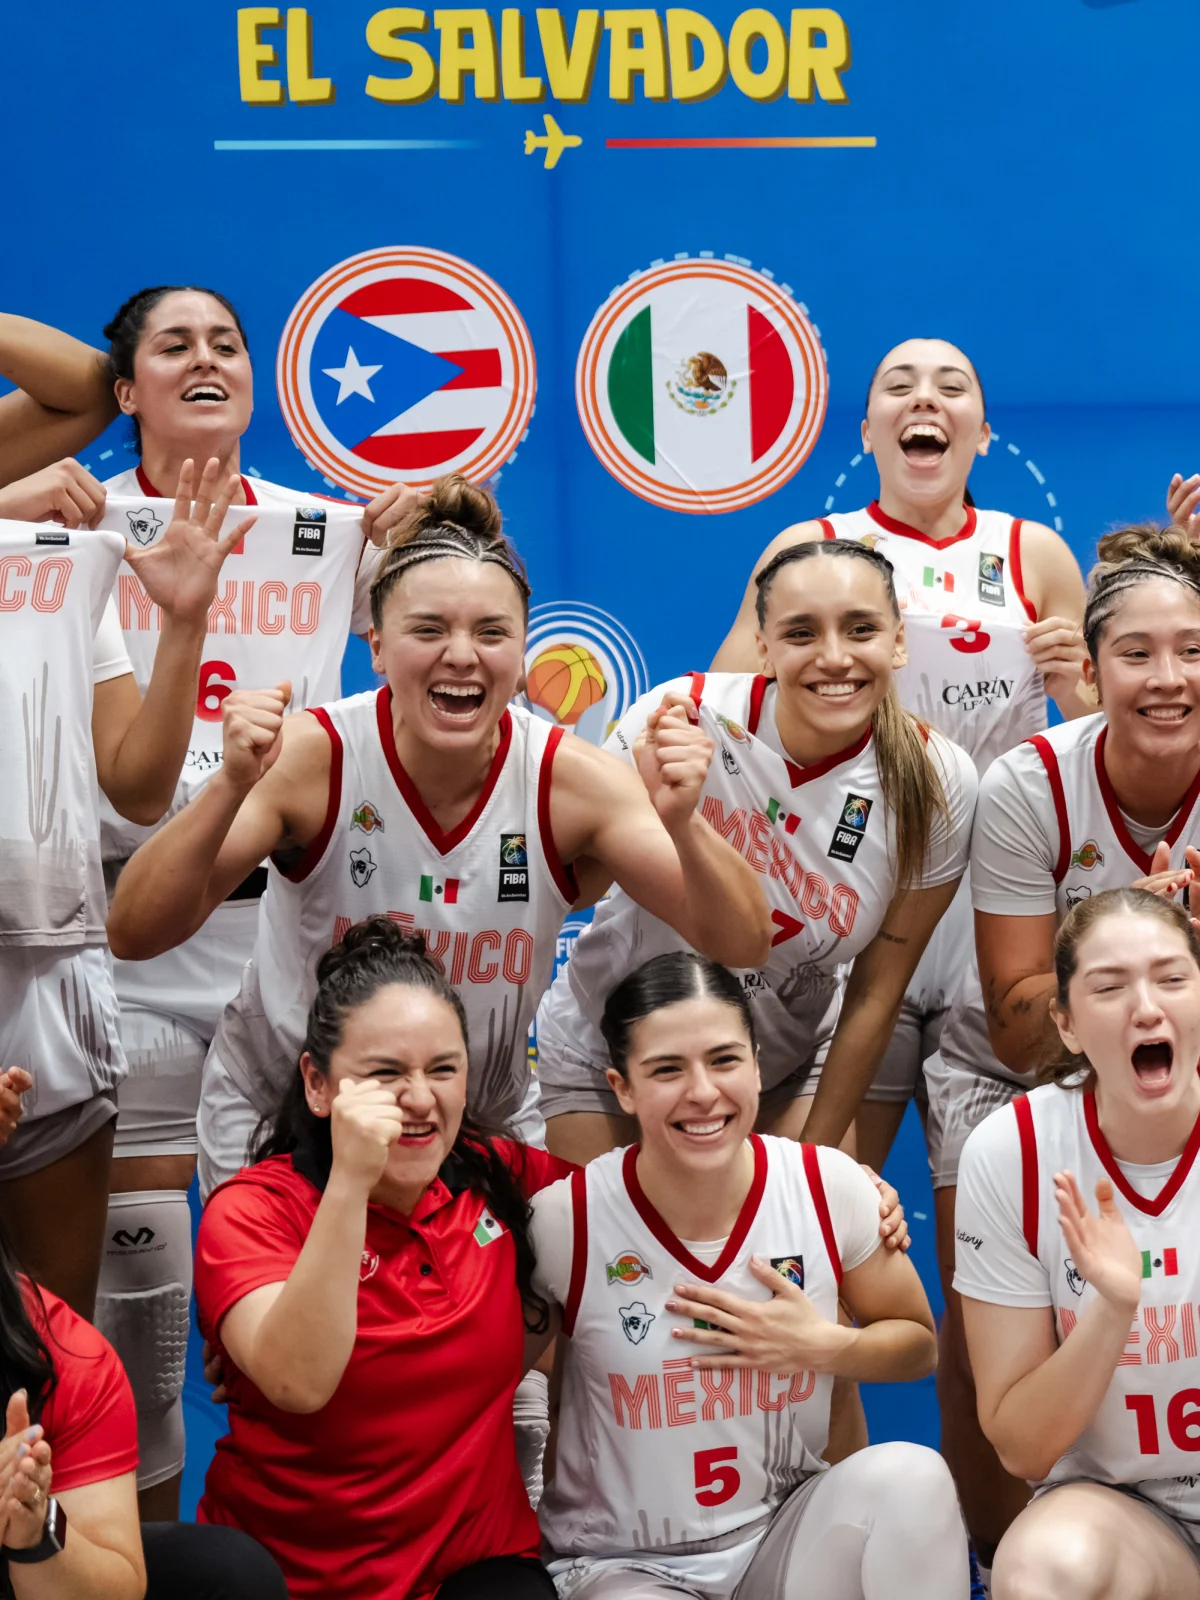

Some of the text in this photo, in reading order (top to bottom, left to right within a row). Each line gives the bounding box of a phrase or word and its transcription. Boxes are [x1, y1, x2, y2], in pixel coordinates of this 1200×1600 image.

[237, 7, 852, 106] EL SALVADOR
[298, 527, 321, 540] FIBA
[118, 575, 322, 635] MXICO
[941, 613, 991, 653] 3
[195, 660, 236, 723] 6
[942, 676, 1015, 705] CARÍN
[836, 830, 858, 846] FIBA
[503, 872, 527, 885] FIBA
[607, 1357, 816, 1430] MÉXICO
[693, 1446, 741, 1507] 5
